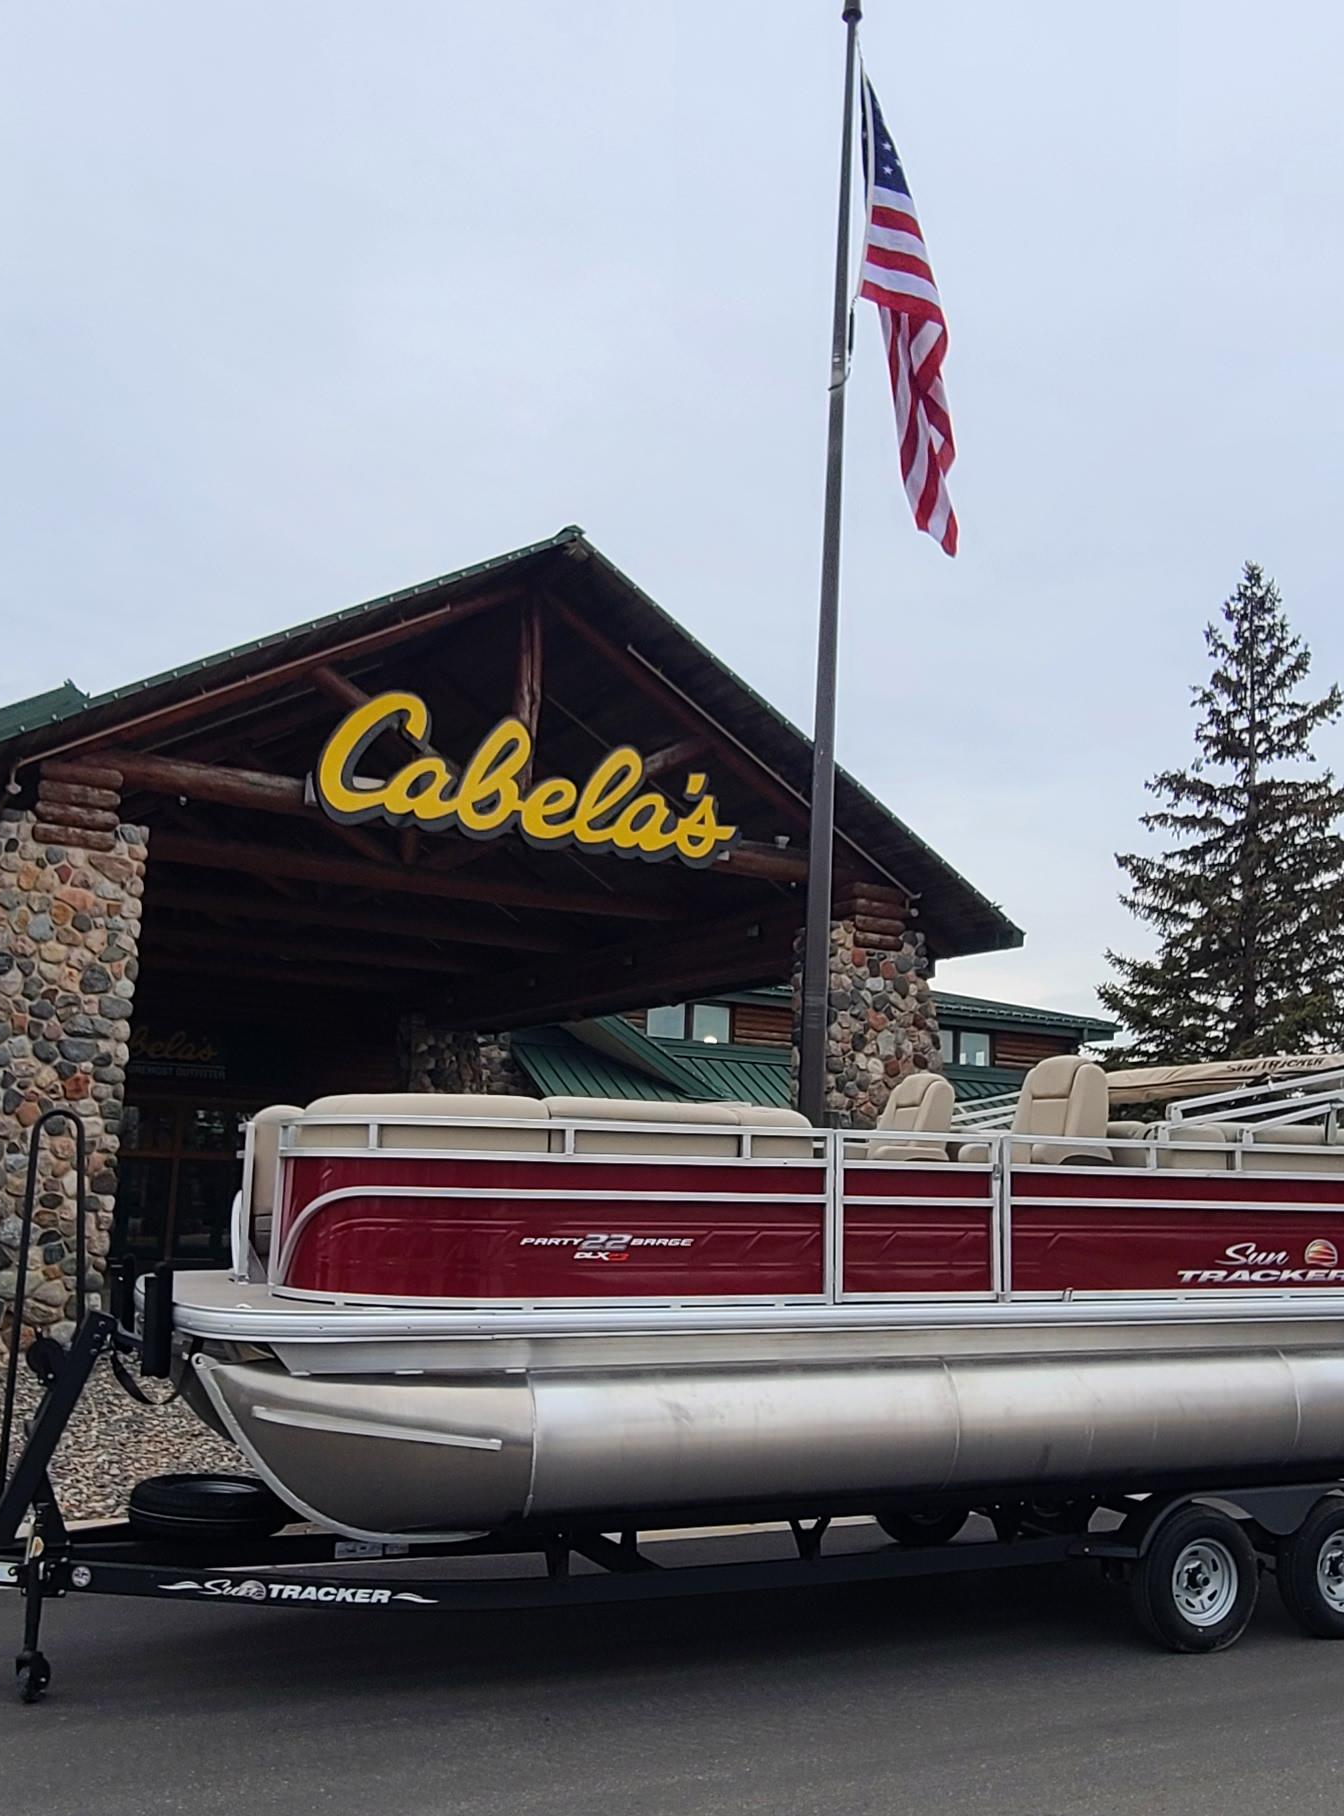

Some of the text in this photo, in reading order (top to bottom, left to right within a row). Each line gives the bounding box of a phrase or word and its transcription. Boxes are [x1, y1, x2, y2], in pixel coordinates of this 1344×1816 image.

[318, 691, 737, 862] Cabela's
[129, 1025, 218, 1061] bela's
[520, 1233, 694, 1251] PARTY 22 BARGE
[1214, 1242, 1290, 1266] Sun
[199, 1579, 392, 1603] Sun TRACKER
